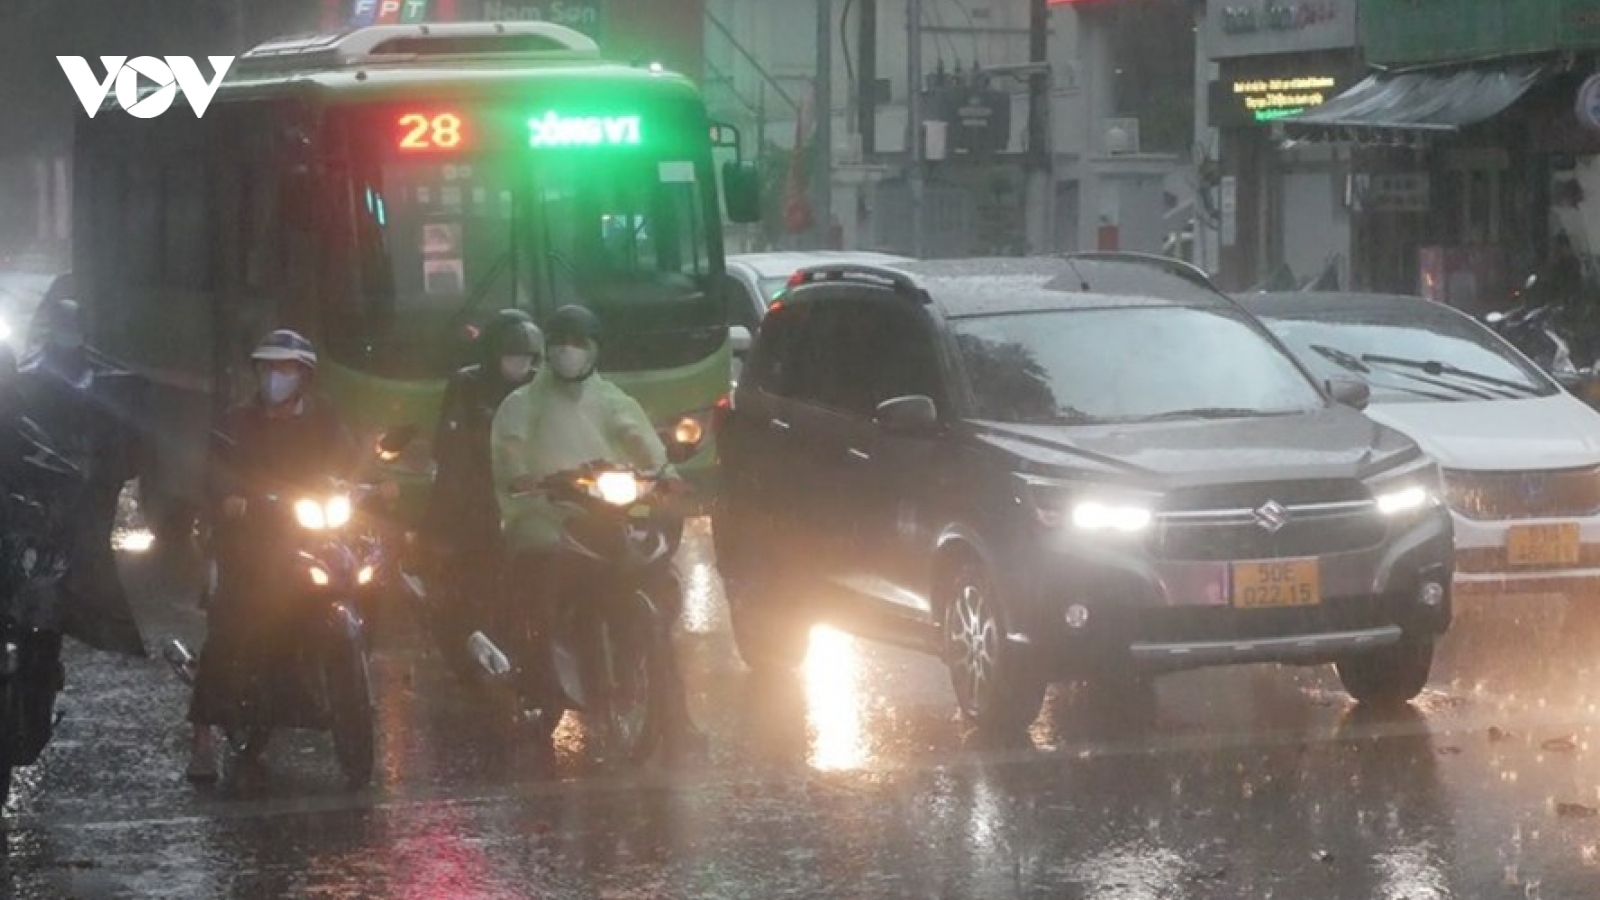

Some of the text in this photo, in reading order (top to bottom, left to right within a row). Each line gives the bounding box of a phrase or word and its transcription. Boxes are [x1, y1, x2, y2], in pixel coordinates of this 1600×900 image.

[356, 1, 424, 18] FPT
[485, 0, 542, 22] Nam
[399, 113, 461, 148] 28
